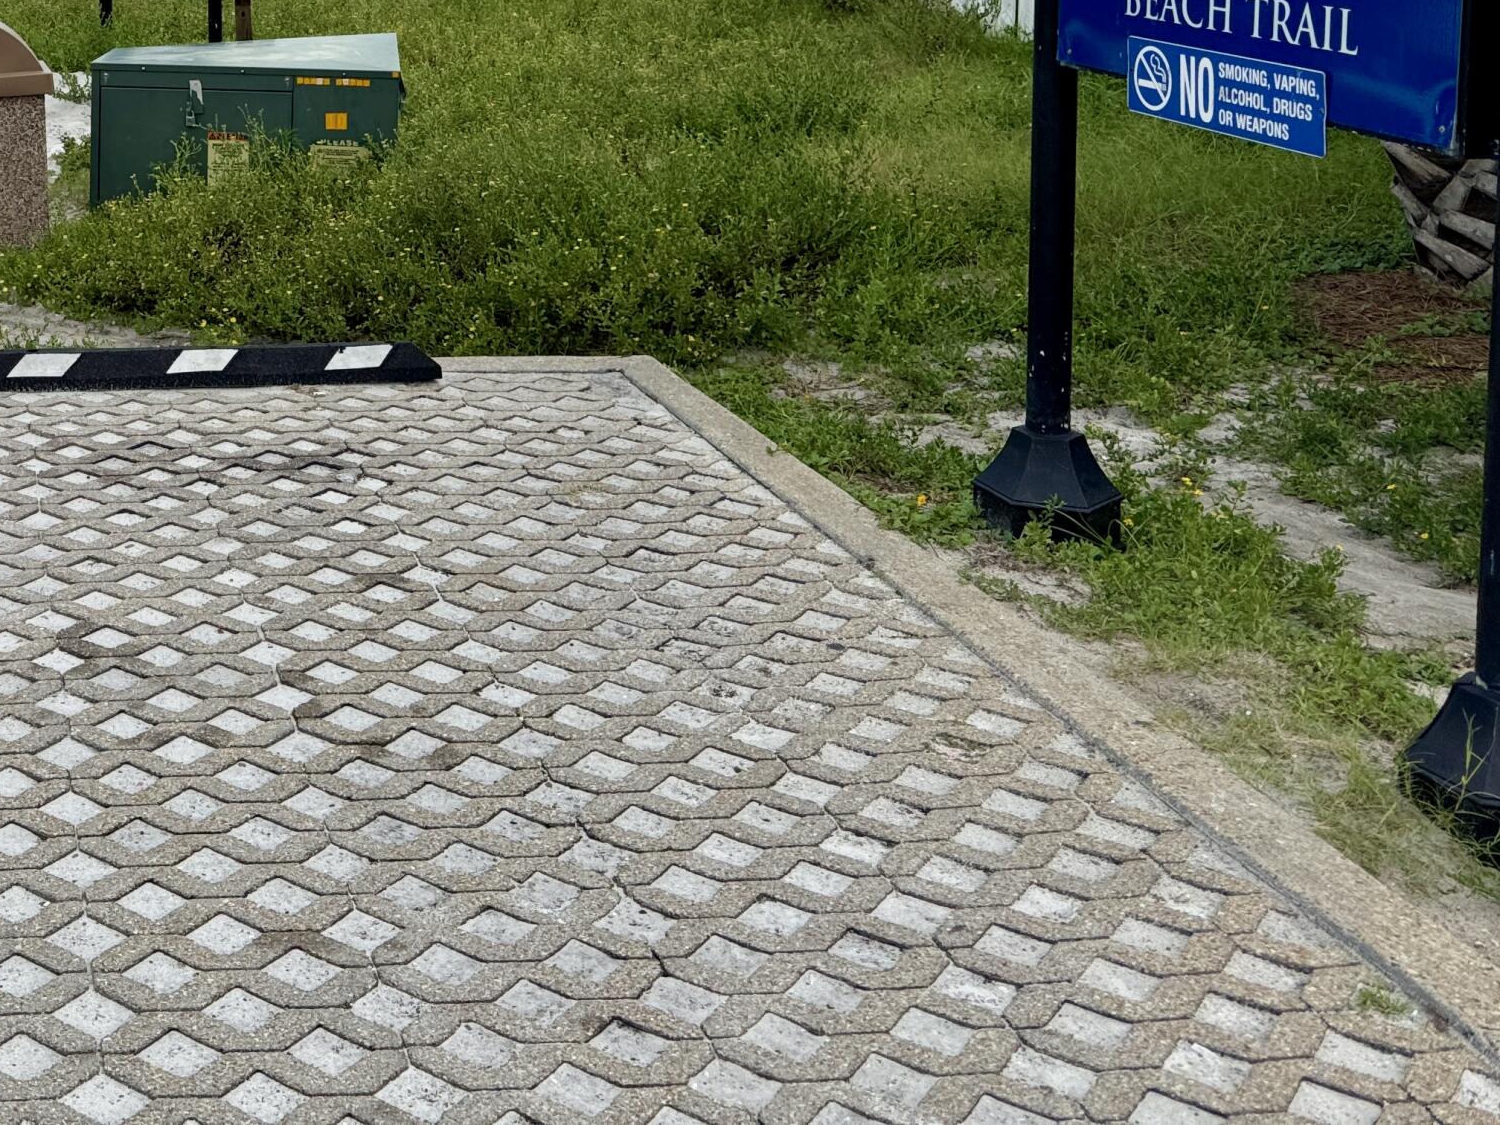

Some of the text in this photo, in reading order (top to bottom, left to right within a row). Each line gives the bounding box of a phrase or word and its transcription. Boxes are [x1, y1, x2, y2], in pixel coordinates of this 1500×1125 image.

[1179, 53, 1215, 123] NO
[1218, 61, 1320, 101] SMOKING, VAPING,
[1218, 85, 1313, 122] ALCOHOL, DRUGS
[1218, 108, 1290, 141] OR WEAPONS
